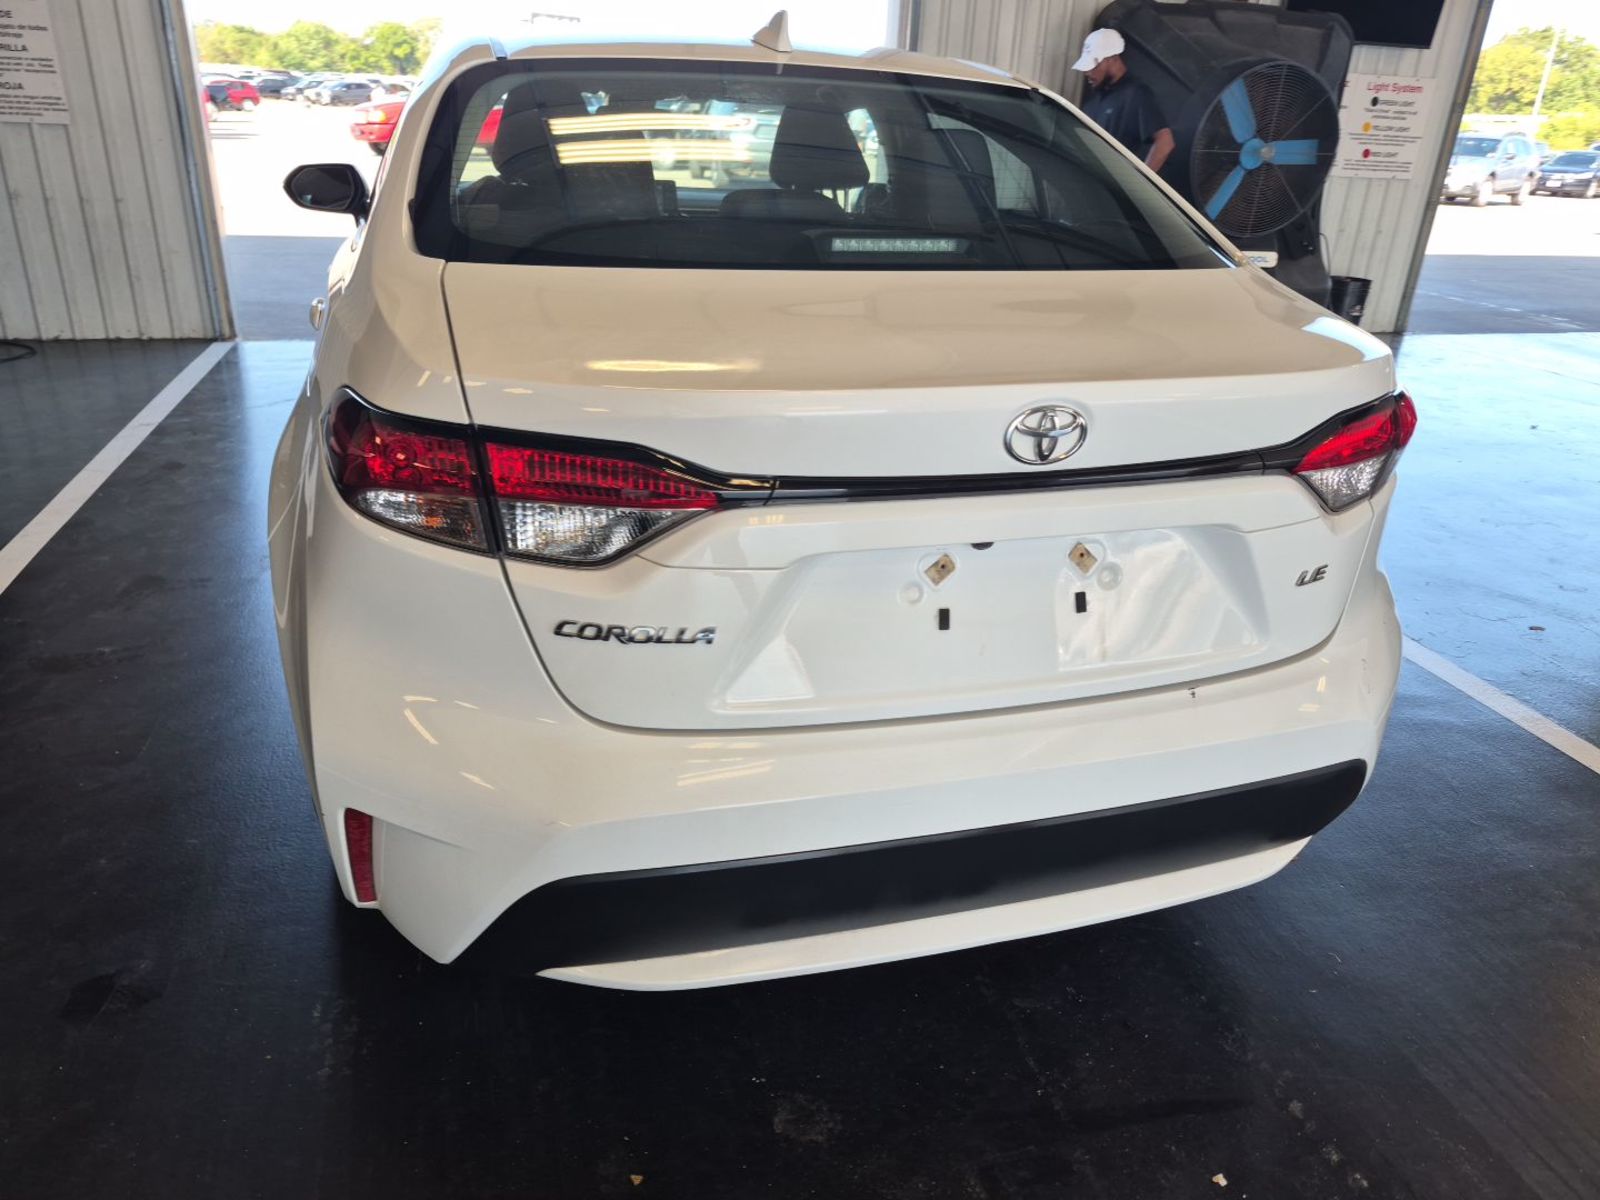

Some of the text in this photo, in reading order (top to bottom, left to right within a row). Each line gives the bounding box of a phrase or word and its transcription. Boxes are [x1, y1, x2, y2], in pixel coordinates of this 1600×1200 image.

[1367, 81, 1424, 95] Light System
[1295, 564, 1328, 587] LE
[553, 619, 717, 645] COROLLA
